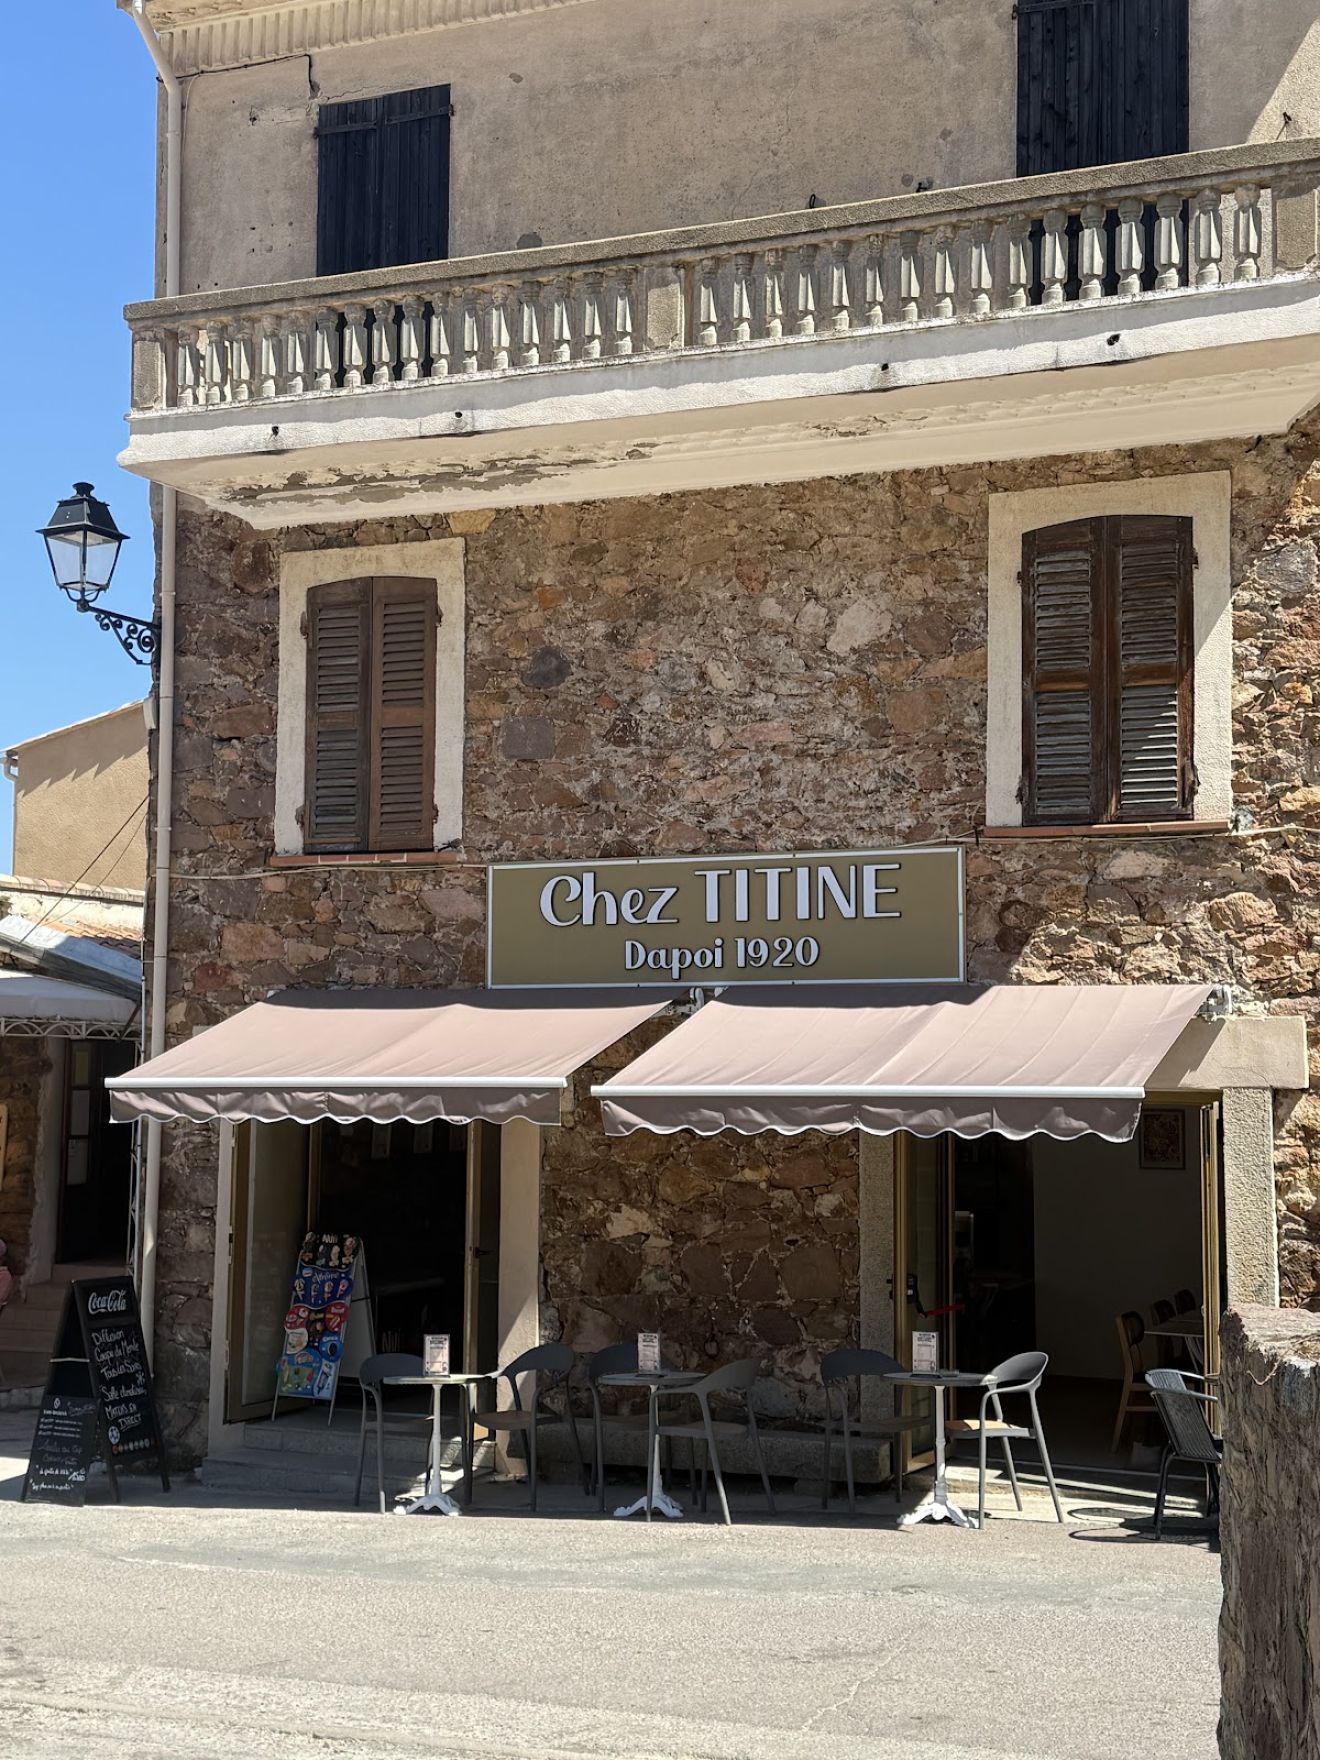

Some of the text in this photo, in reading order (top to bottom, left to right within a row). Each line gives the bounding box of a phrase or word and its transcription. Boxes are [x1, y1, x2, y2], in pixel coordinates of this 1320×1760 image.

[540, 863, 902, 927] Chez TITINE
[624, 936, 820, 980] Dapoi 1920
